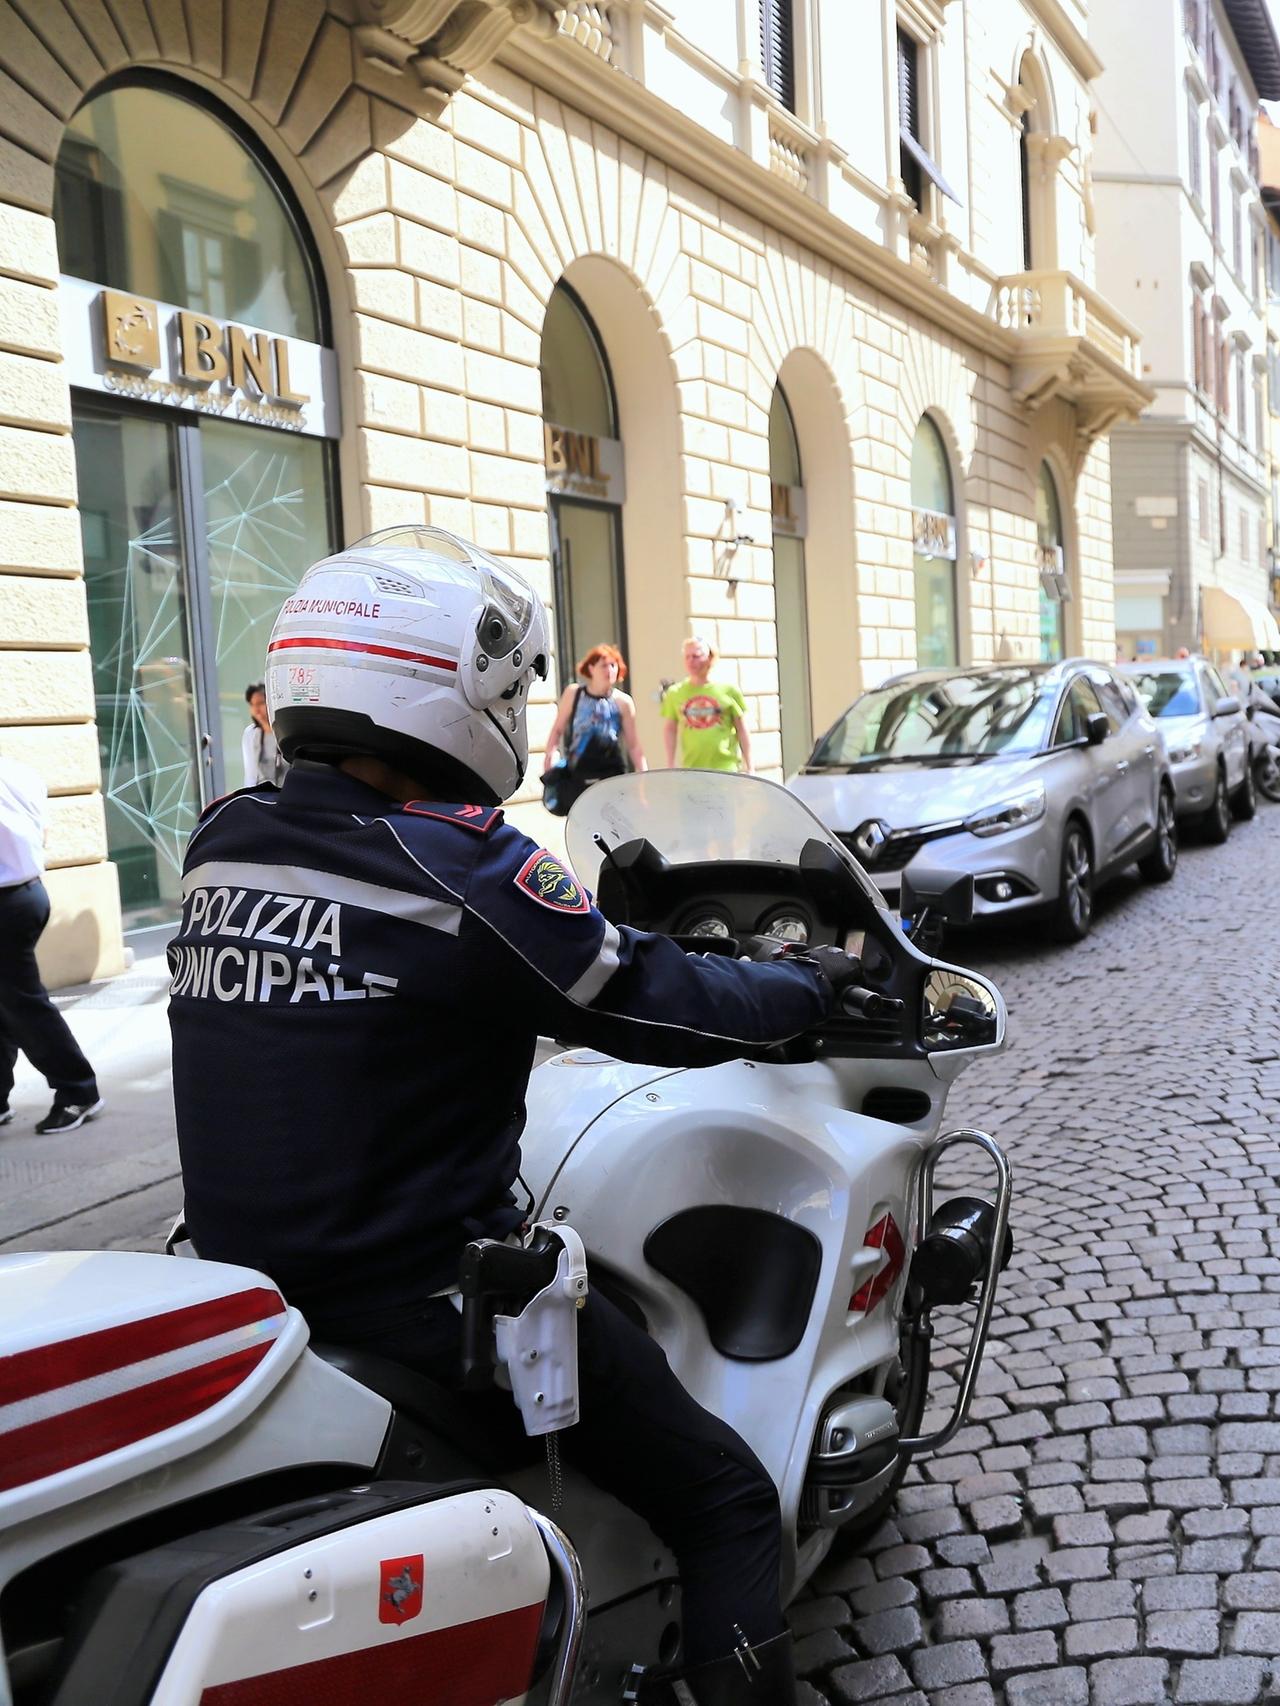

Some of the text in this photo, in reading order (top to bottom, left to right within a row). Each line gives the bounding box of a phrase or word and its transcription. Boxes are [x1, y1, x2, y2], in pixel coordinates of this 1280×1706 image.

[178, 311, 311, 404] BNL
[544, 423, 611, 481] BNL
[308, 599, 381, 618] MUNICIPALE
[184, 887, 342, 957] POLIZIA
